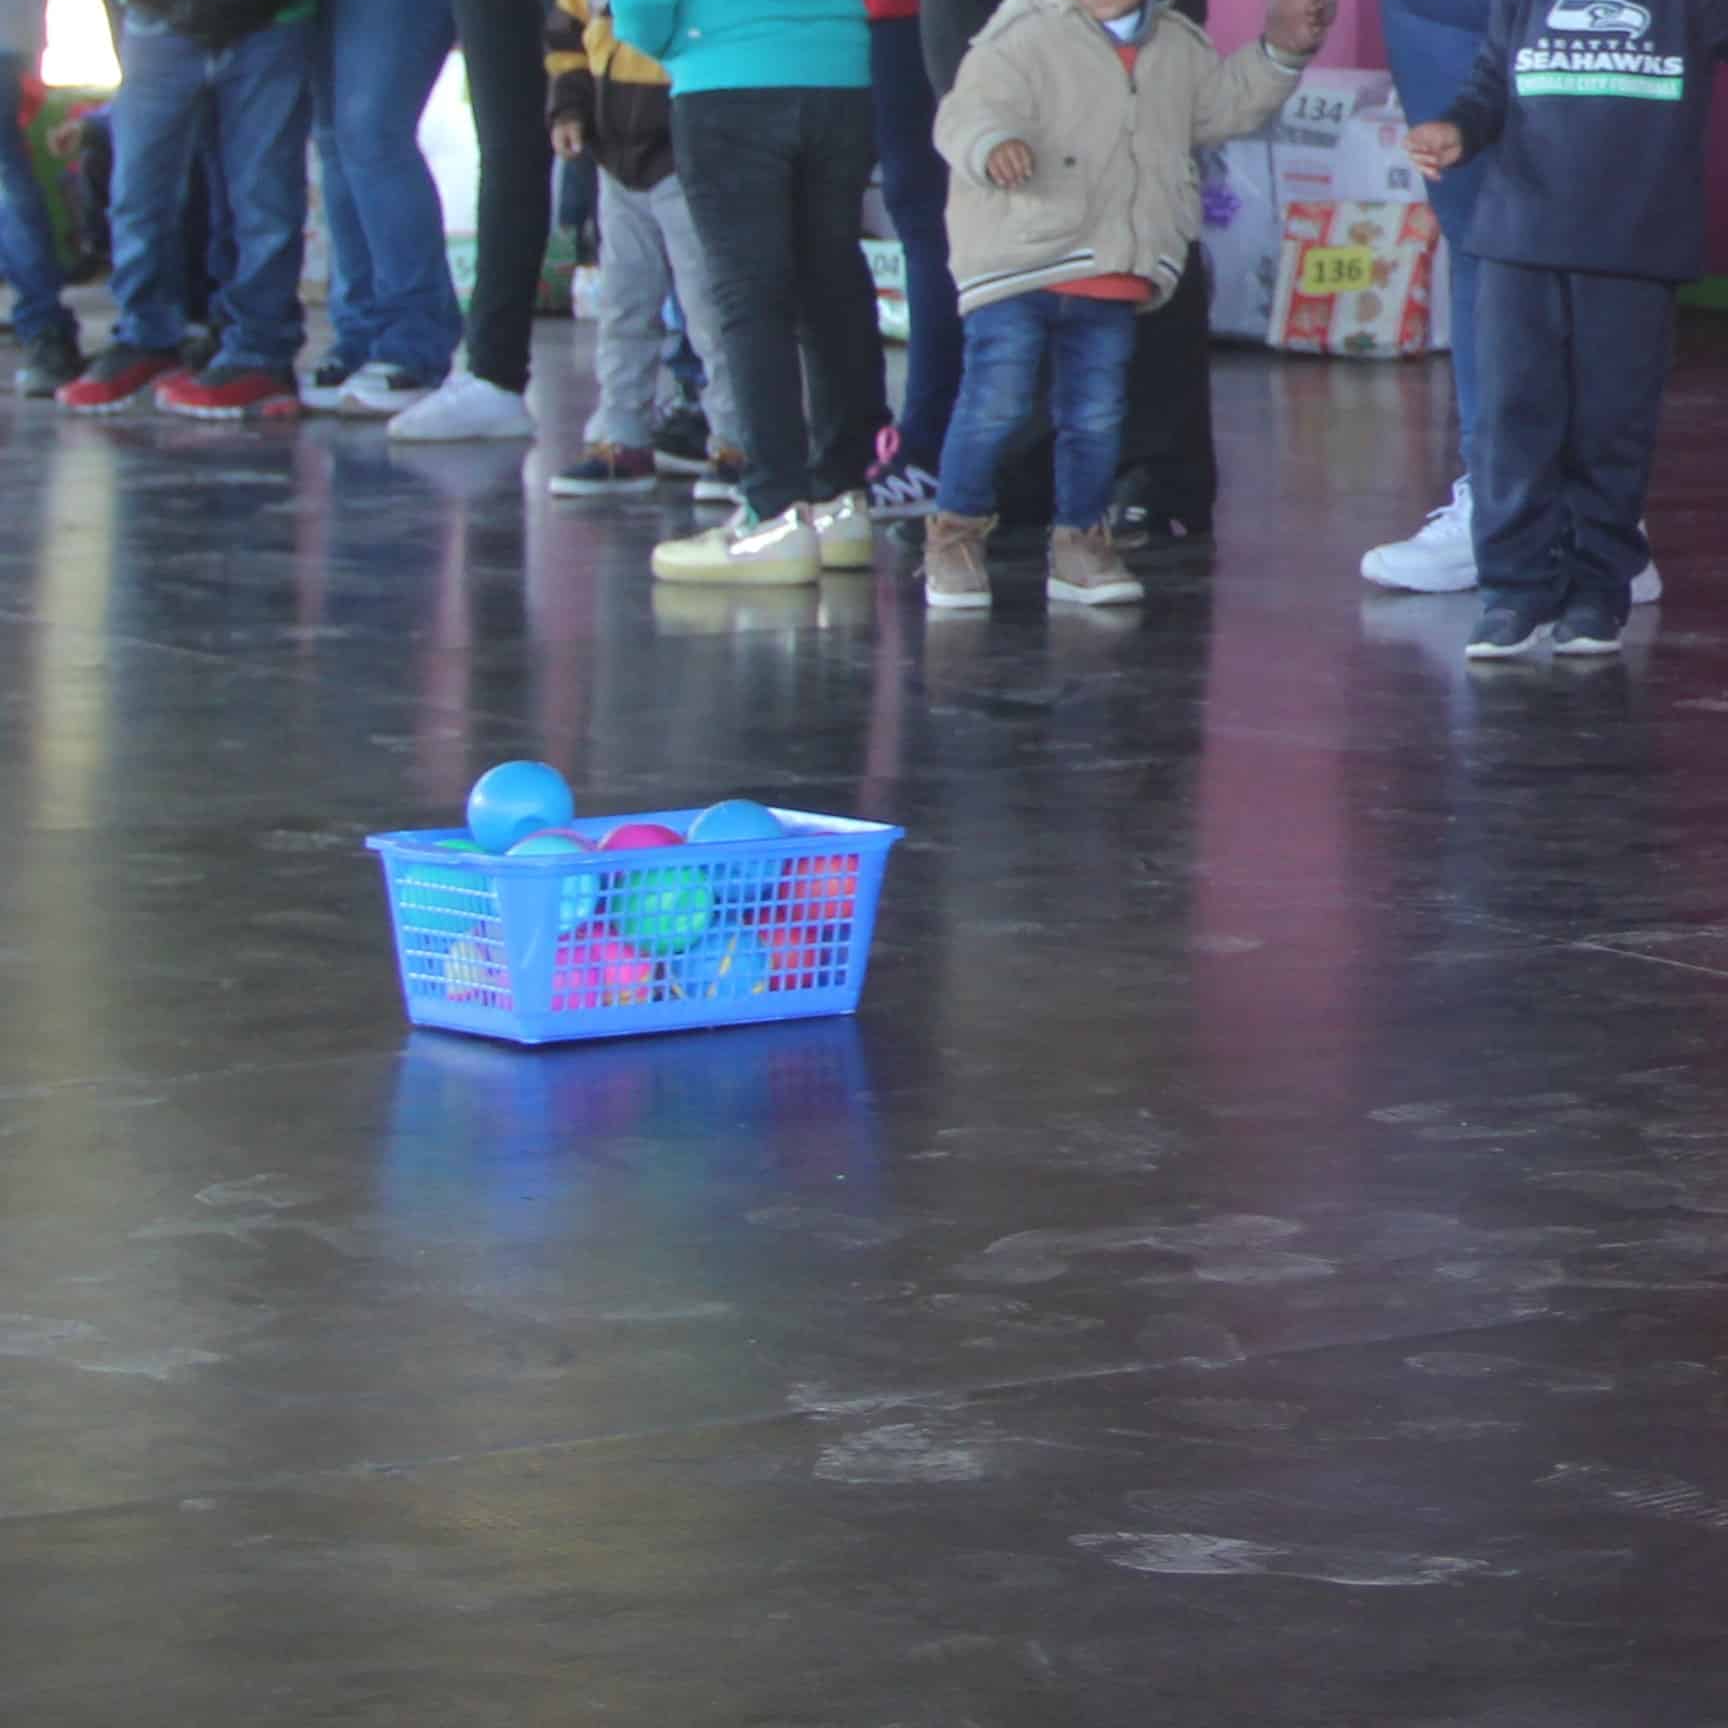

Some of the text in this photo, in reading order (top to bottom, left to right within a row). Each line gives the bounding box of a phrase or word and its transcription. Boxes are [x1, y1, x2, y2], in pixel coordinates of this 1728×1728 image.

[1537, 37, 1656, 53] SEATTLE
[1514, 47, 1684, 76] SEAHAWKS
[1294, 95, 1344, 124] 134
[1312, 258, 1363, 284] 136
